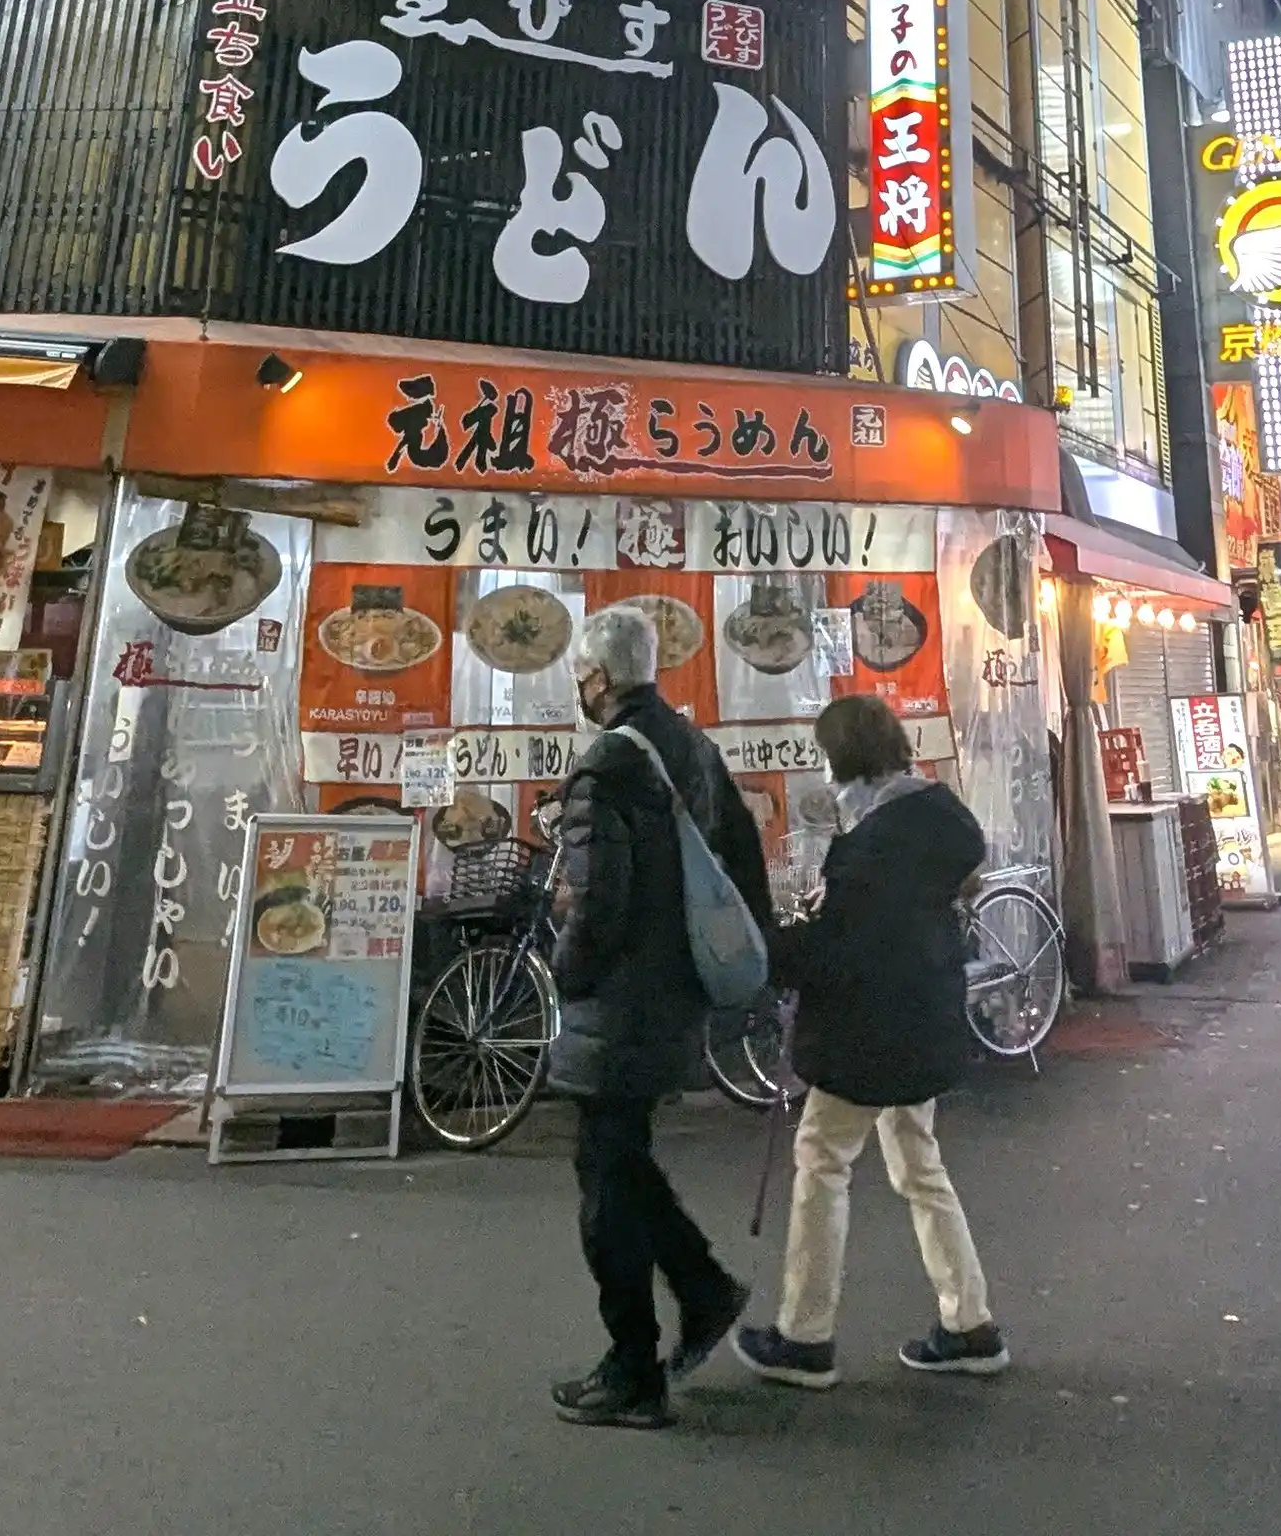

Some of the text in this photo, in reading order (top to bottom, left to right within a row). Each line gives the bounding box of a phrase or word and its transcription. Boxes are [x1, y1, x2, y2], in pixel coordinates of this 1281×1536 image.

[705, 3, 733, 60] うどん
[734, 7, 760, 63] えびす
[269, 38, 837, 304] うどん
[873, 111, 933, 237] 王将
[386, 374, 835, 477] 元祖極らうめん
[853, 407, 884, 445] 元祖
[423, 496, 593, 566] うまい!
[713, 504, 878, 568] おいしい!
[337, 737, 405, 781] 早い!
